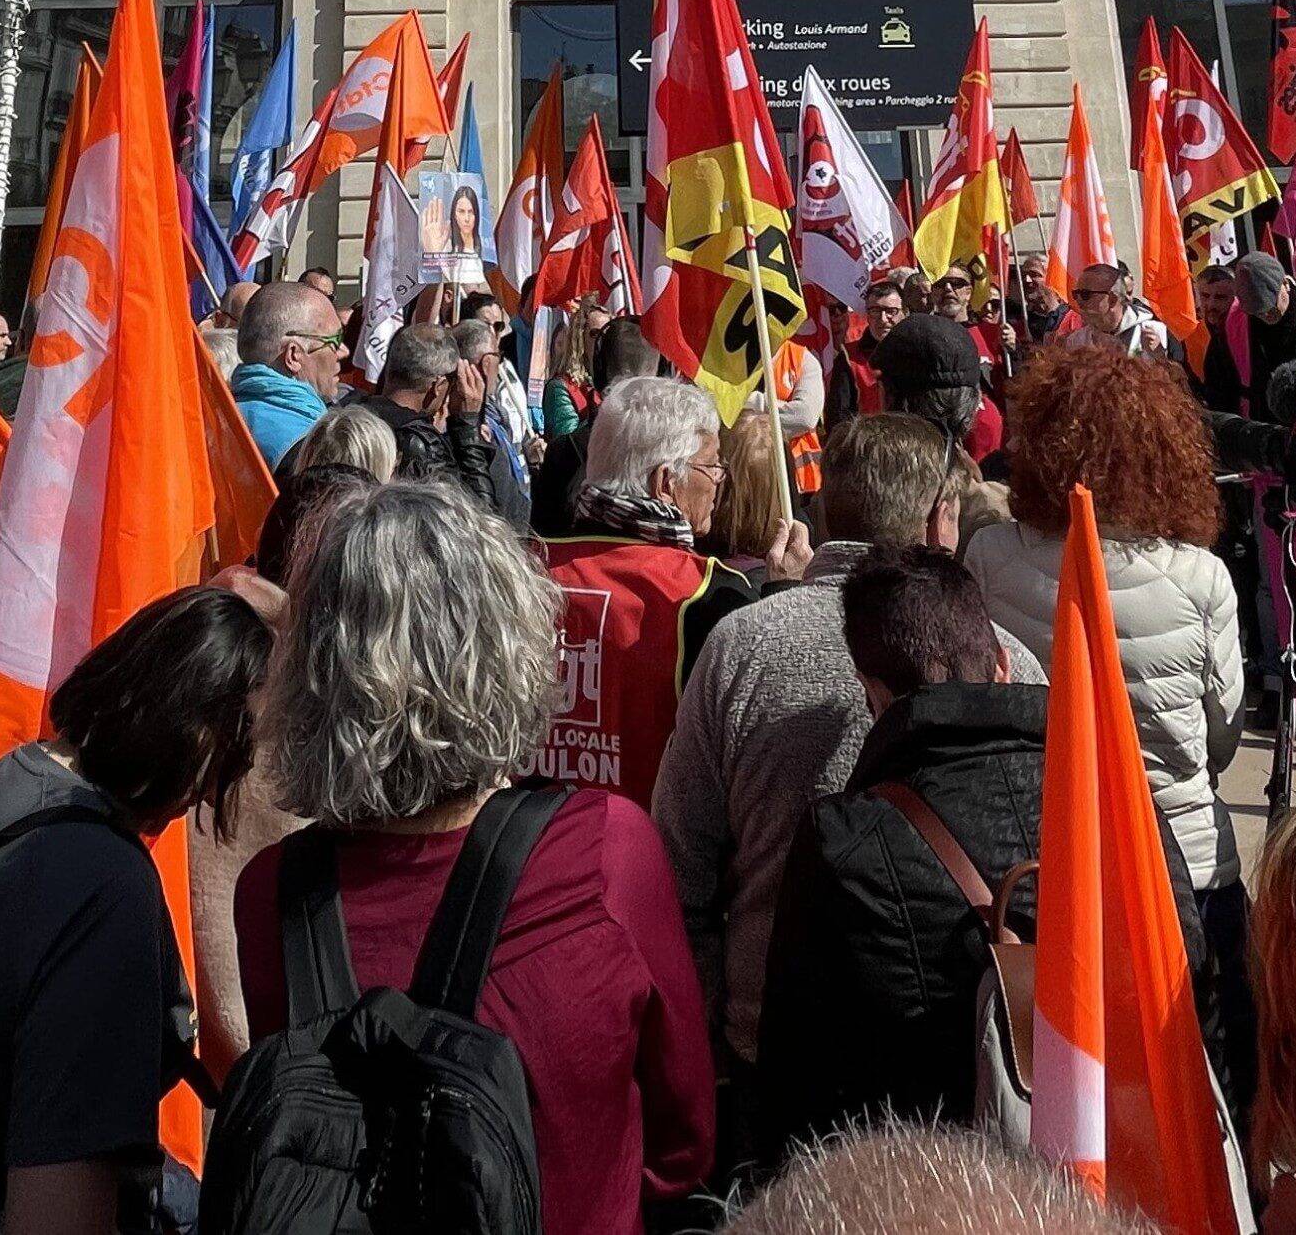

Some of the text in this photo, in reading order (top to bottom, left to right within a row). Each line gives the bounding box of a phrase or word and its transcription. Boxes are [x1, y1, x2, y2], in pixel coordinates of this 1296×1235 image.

[795, 23, 823, 35] Louis
[825, 23, 868, 35] Armand
[767, 40, 827, 51] Autostazione
[759, 76, 787, 96] ing
[841, 77, 891, 91] roues
[855, 97, 876, 107] area
[885, 96, 933, 107] Parcheggio
[935, 95, 943, 105] 2
[555, 639, 600, 714] gt
[553, 728, 621, 753] LOCALE
